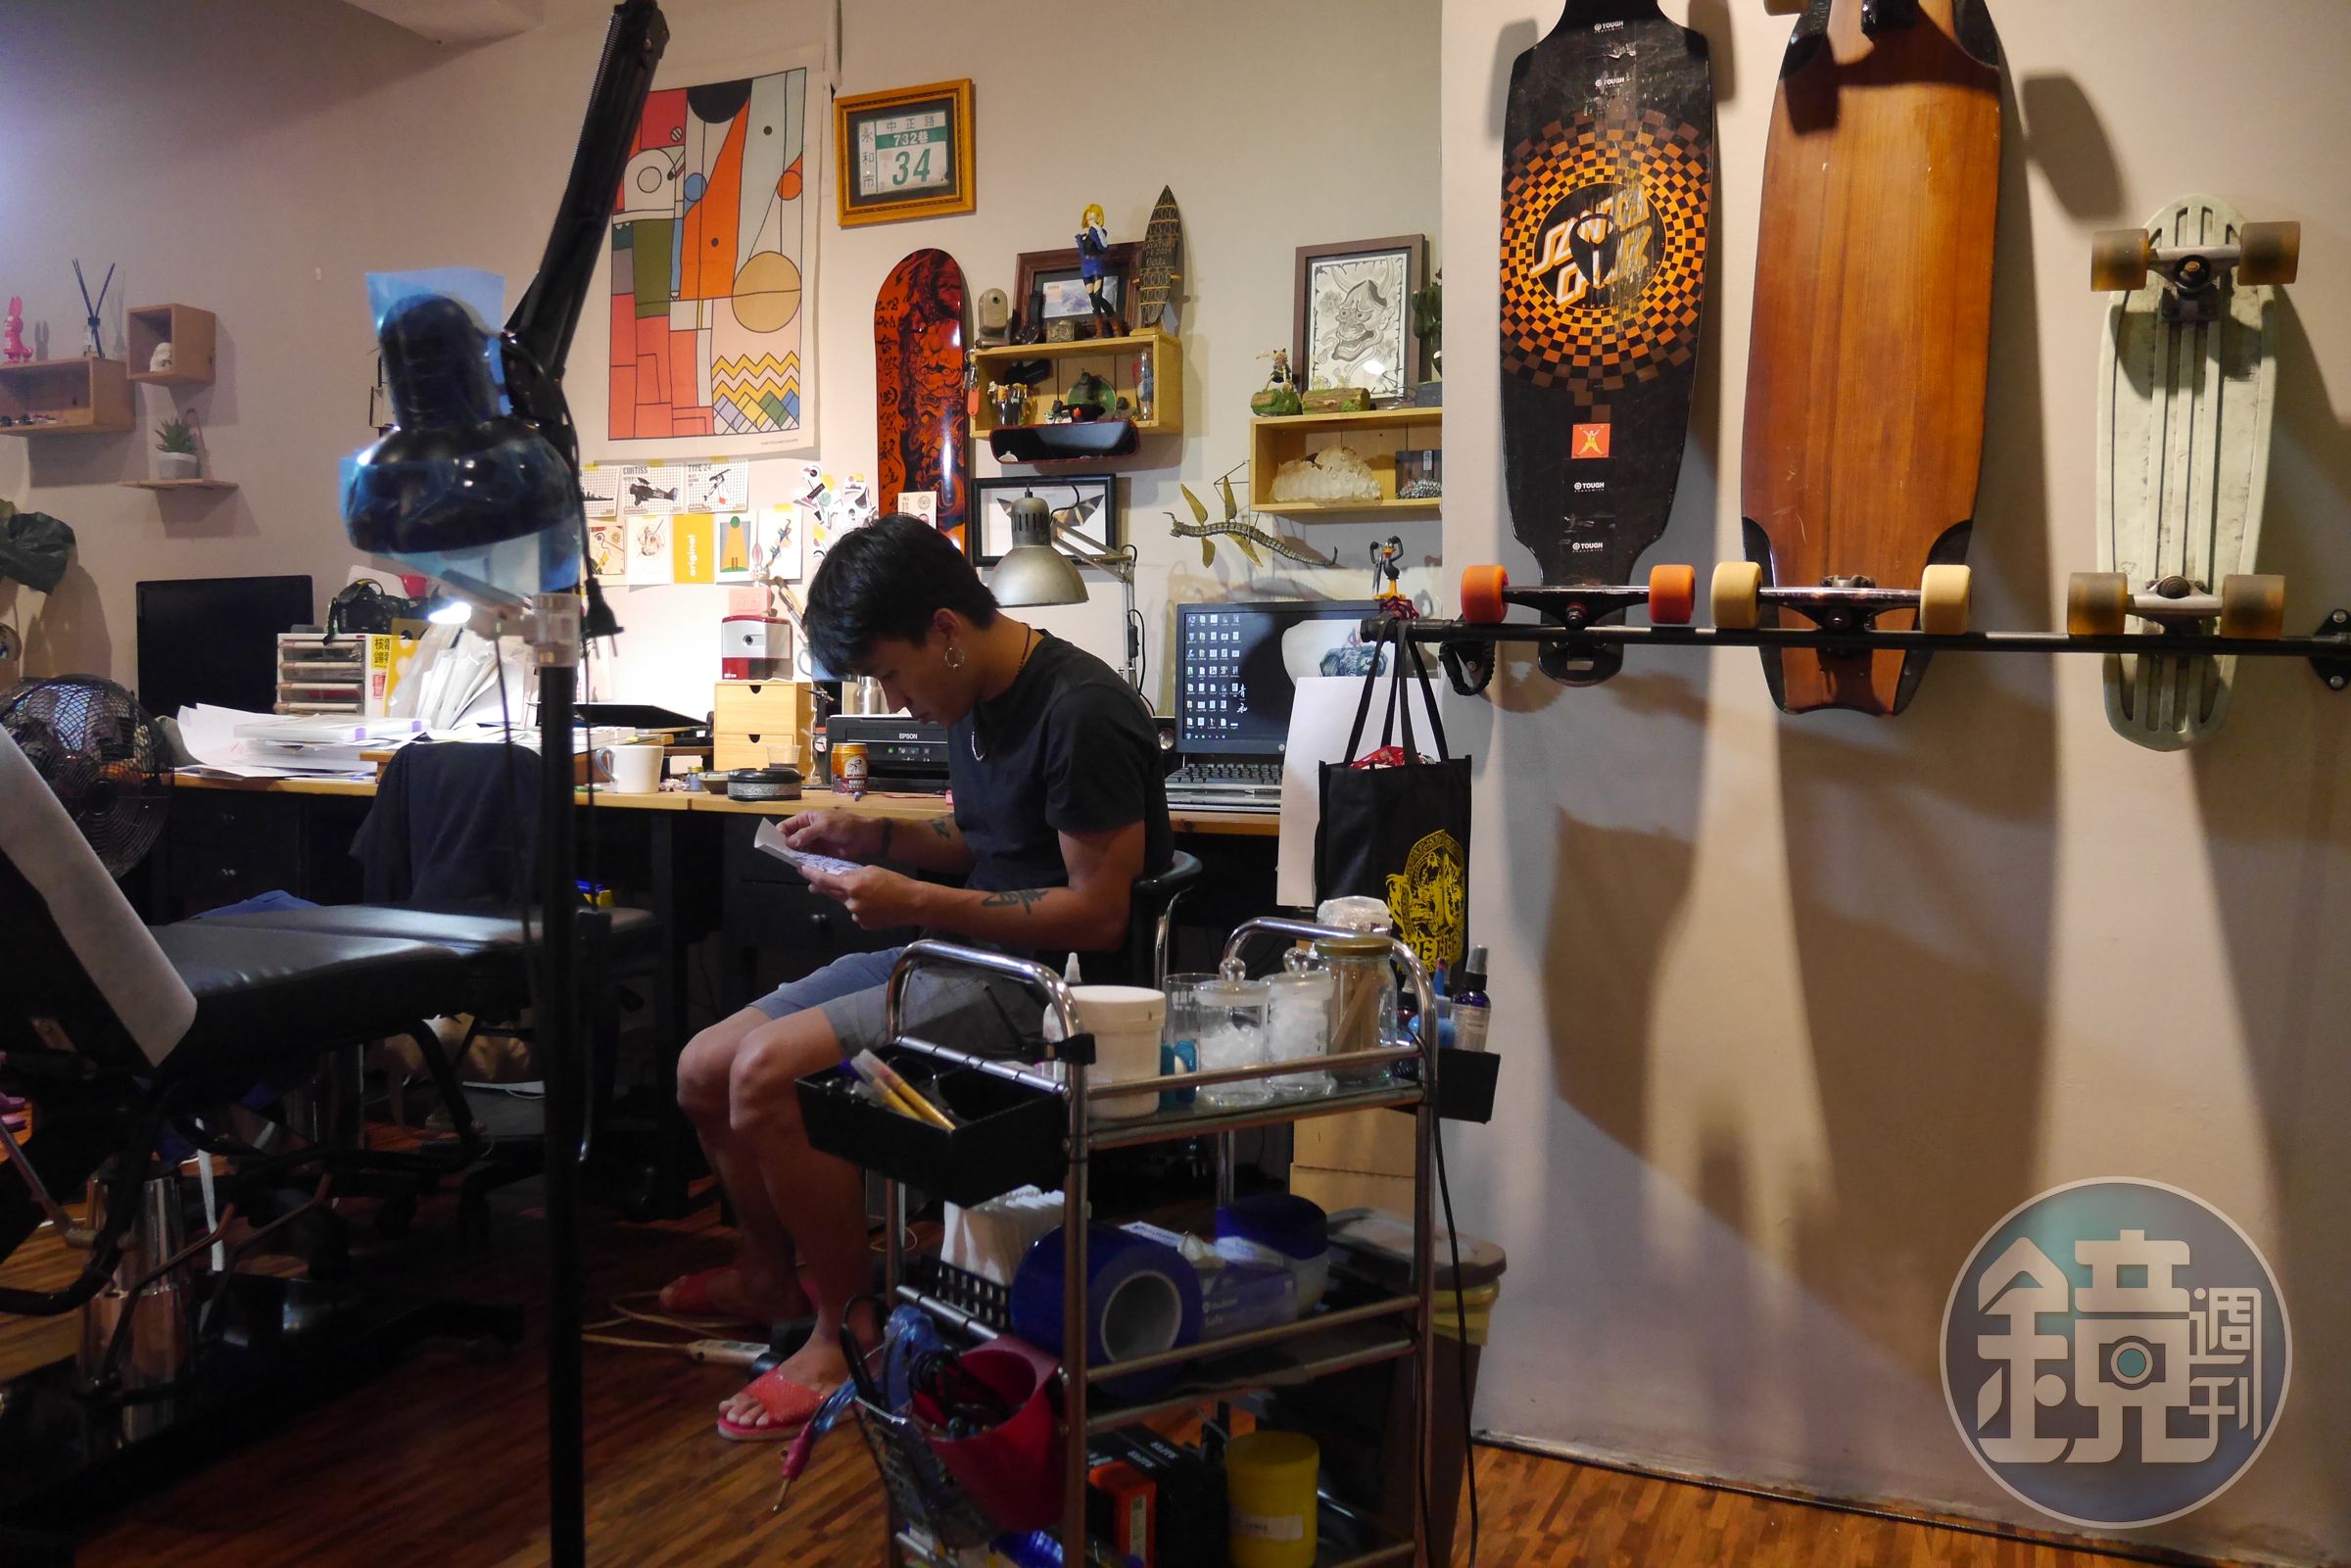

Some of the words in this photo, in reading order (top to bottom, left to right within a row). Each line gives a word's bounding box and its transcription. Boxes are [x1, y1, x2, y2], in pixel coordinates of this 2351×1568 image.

[1602, 20, 1624, 29] TOUGH
[1603, 76, 1625, 86] TOUGH
[886, 115, 936, 131] 中正路
[892, 129, 930, 147] 732巷
[860, 127, 876, 189] 永和市
[891, 148, 932, 186] 34
[622, 466, 648, 475] CURTISS
[1582, 481, 1605, 490] TOUGH
[687, 534, 697, 577] original
